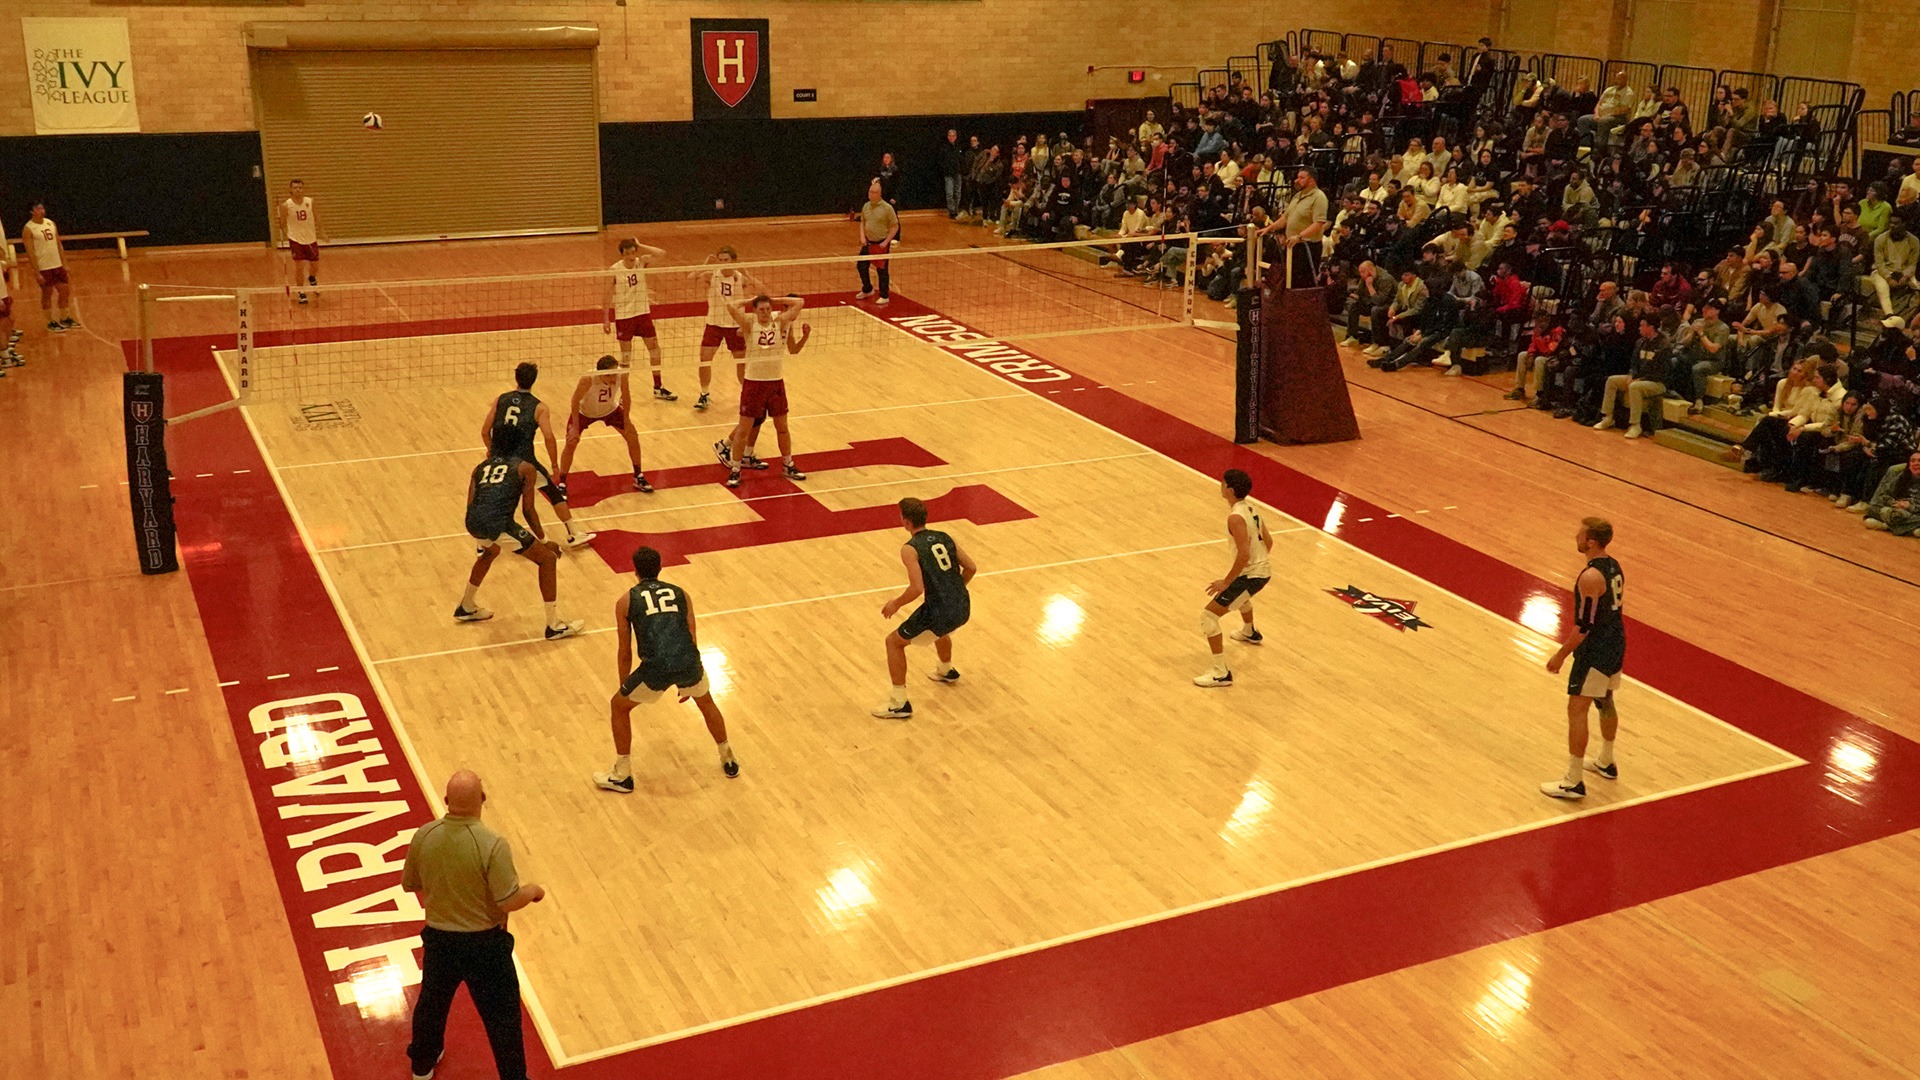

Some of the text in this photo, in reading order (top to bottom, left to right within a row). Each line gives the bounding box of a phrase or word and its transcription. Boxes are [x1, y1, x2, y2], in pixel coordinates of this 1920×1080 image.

[53, 49, 84, 58] THE
[716, 39, 745, 84] H
[57, 61, 126, 88] IVY
[62, 90, 130, 104] LEAGUE
[296, 210, 307, 220] 18
[41, 229, 54, 241] 16
[721, 282, 732, 296] 13
[1186, 251, 1195, 314] CRIMSON
[240, 309, 248, 388] HARVARD
[757, 331, 776, 346] 22
[890, 314, 1072, 383] CRIMSON
[599, 388, 612, 402] 21
[136, 403, 149, 418] H
[504, 406, 521, 427] 6
[478, 464, 509, 484] 18
[135, 425, 163, 569] HARVARD
[931, 543, 952, 571] 8
[640, 587, 679, 616] 12
[248, 692, 427, 1006] HARVARD
